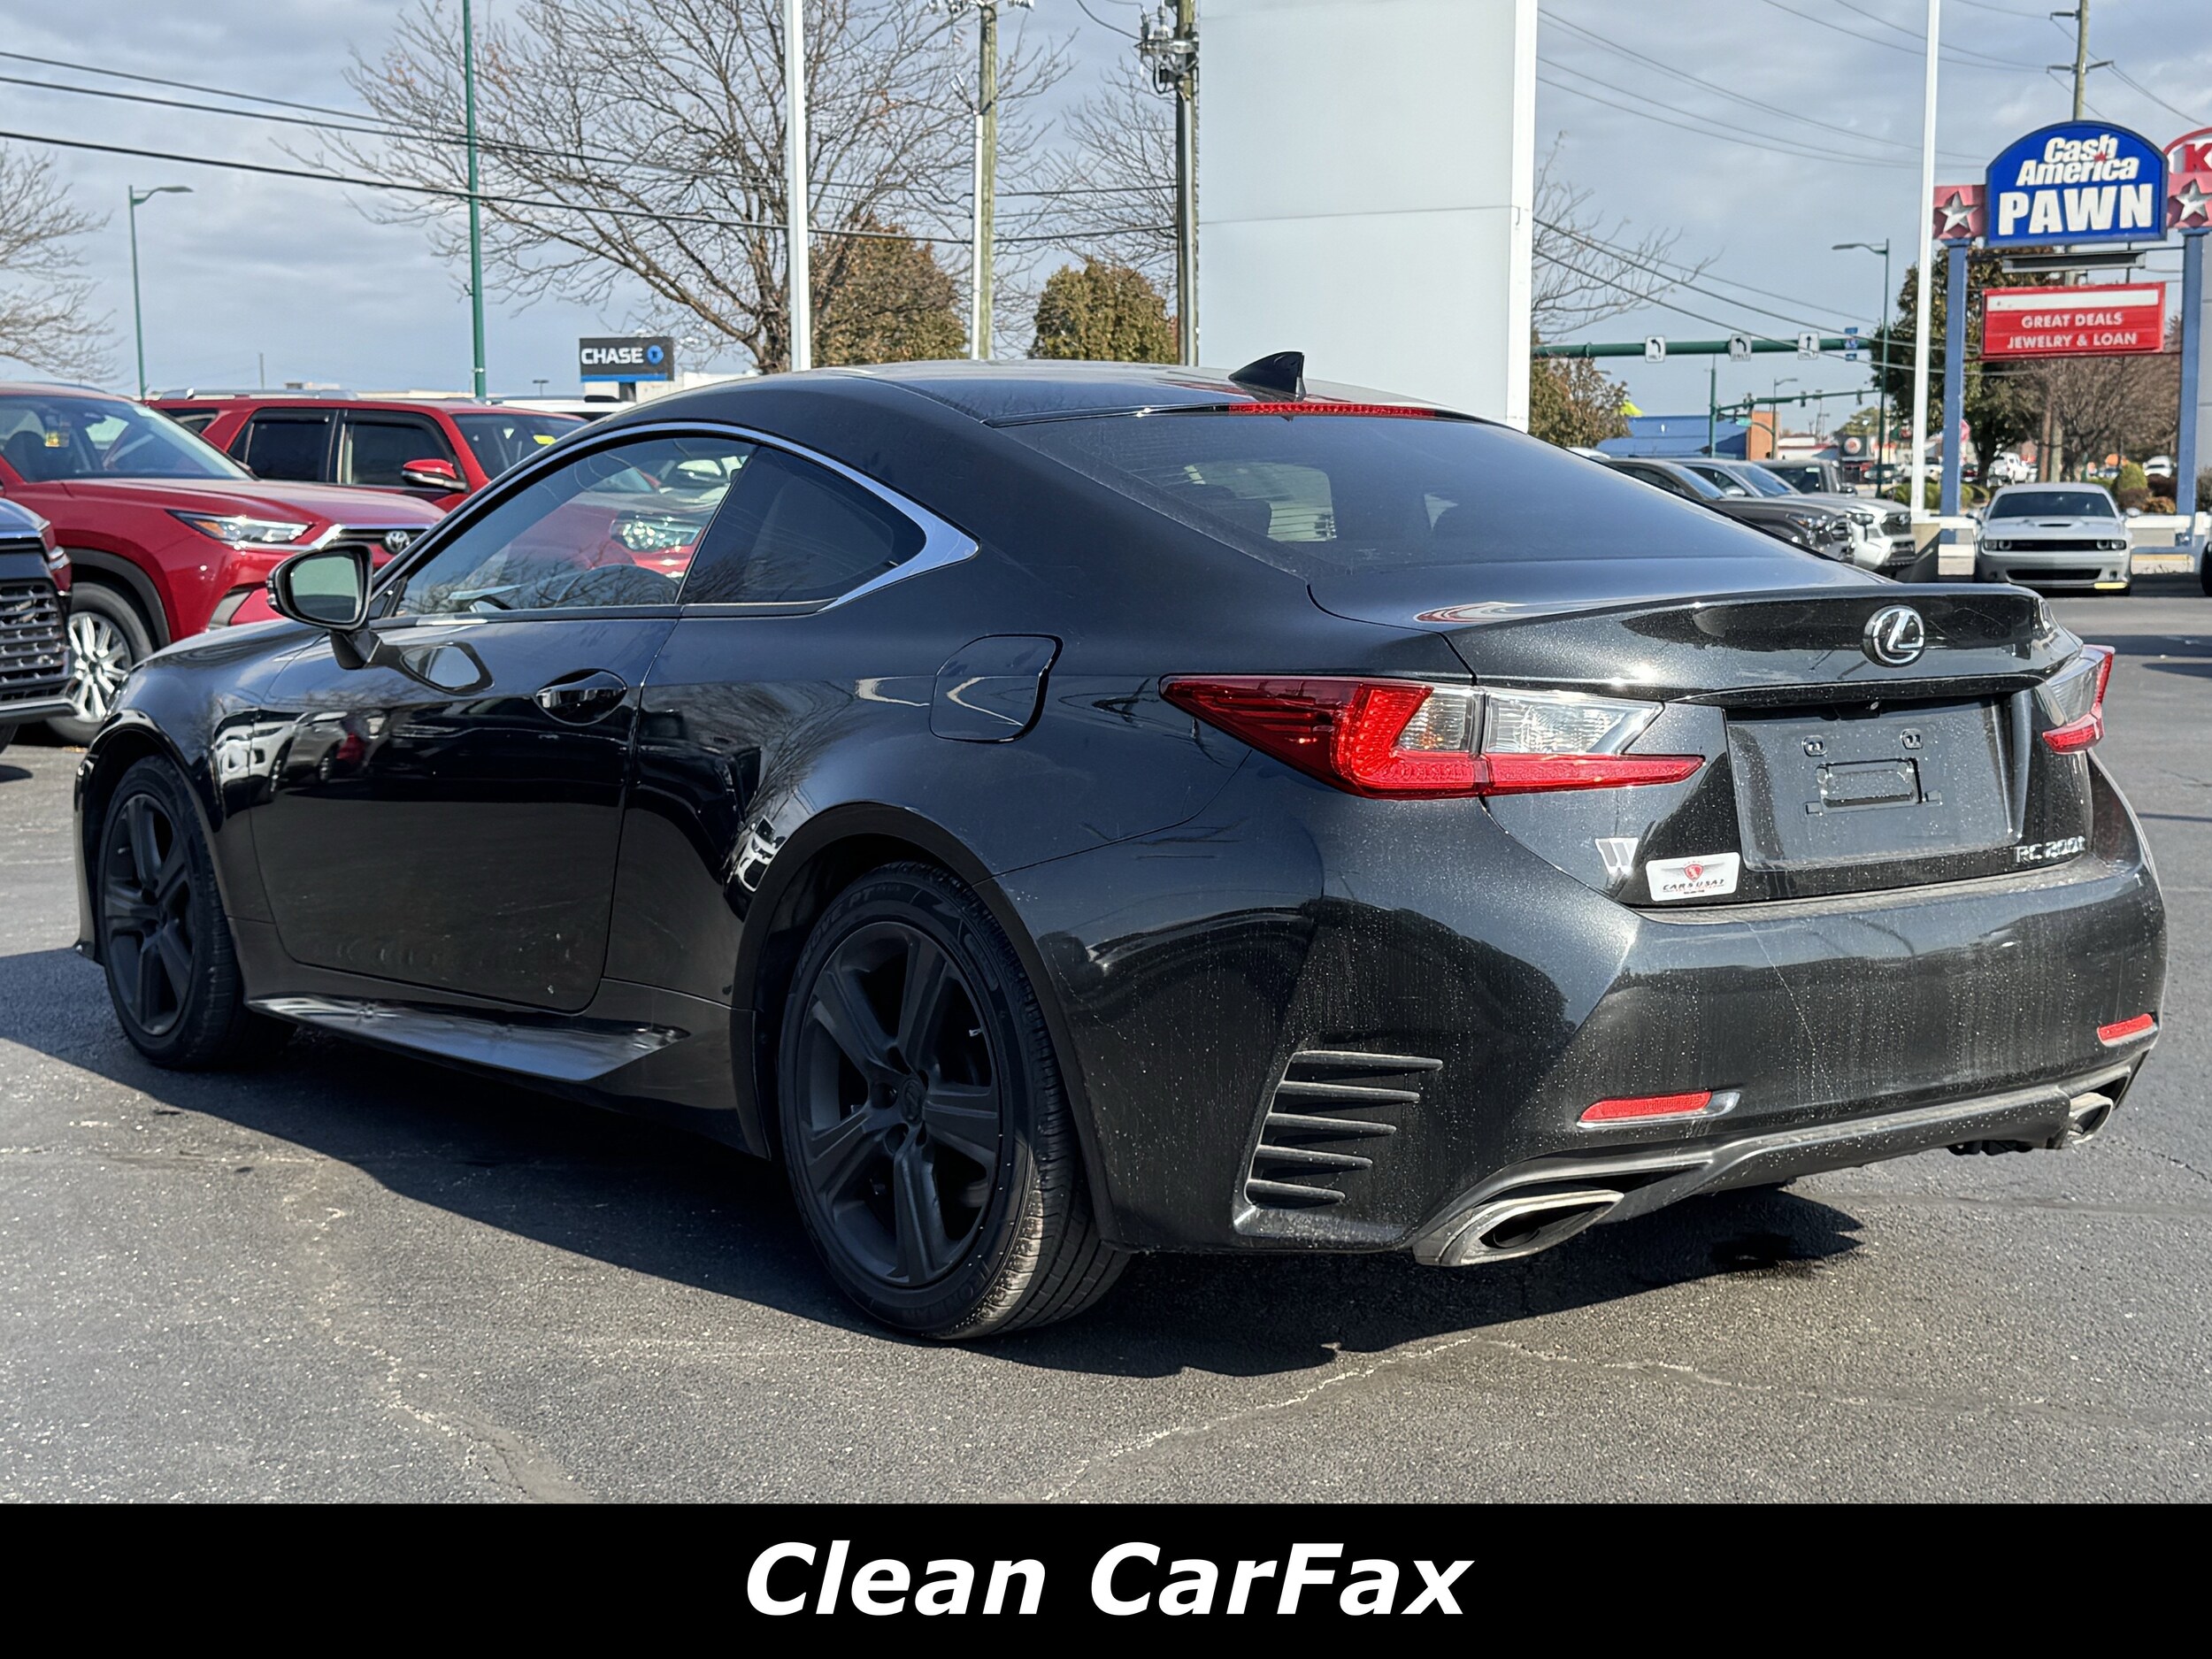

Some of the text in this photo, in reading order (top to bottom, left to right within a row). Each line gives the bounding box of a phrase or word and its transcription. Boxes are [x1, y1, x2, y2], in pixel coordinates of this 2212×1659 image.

[2044, 134, 2118, 164] Cash
[2016, 157, 2139, 186] America
[1998, 183, 2153, 235] PAWN
[2022, 311, 2124, 328] GREAT DEALS
[2007, 332, 2137, 349] JEWELRY & LOAN
[581, 347, 644, 365] CHASE
[2015, 843, 2042, 863] RC
